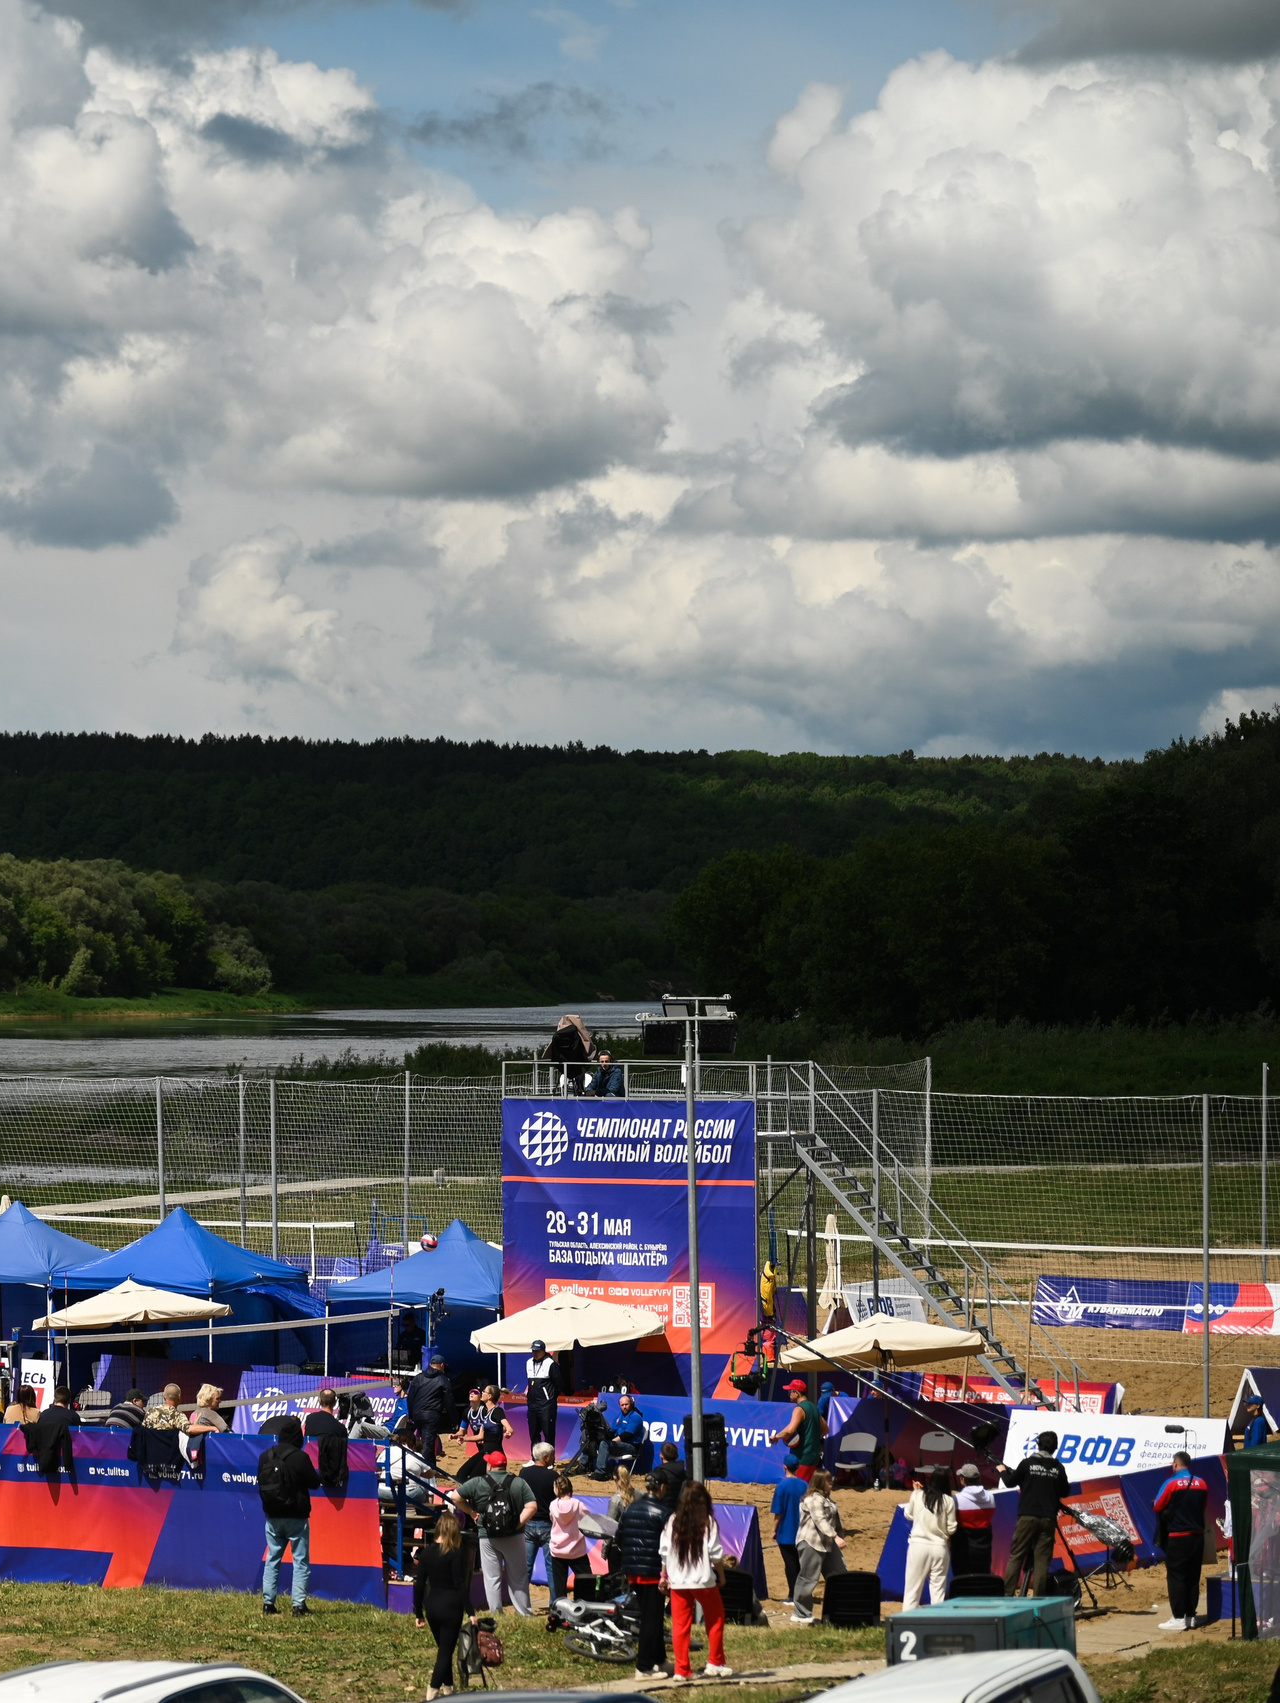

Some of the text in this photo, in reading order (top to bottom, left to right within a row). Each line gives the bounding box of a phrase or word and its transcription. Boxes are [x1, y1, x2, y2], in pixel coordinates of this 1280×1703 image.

[576, 1117, 672, 1139] ЧЕМПИОНАТ
[572, 1140, 732, 1164] ПЛЯЖНЫЙ ВОЛЕЙБОЛ
[603, 1218, 632, 1236] МАЯ
[548, 1240, 570, 1248] ТУЛЬСКАЯ
[589, 1242, 622, 1250] АЛЕКСИНСКИЙ
[549, 1249, 668, 1267] БАЗА ОТДЫХА «ШАХТЁР»
[561, 1283, 604, 1297] volley.ru
[630, 1289, 672, 1297] VOLLEYVFV
[21, 1371, 47, 1385] ЕСЬ
[947, 1389, 993, 1400] voley.ru
[672, 1424, 777, 1448] VYVFV
[1056, 1434, 1136, 1467] ВФВ
[1143, 1439, 1207, 1450] Всероссийская
[97, 1467, 130, 1477] vc_tulitsa
[232, 1473, 259, 1486] volley.
[900, 1630, 917, 1661] 2
